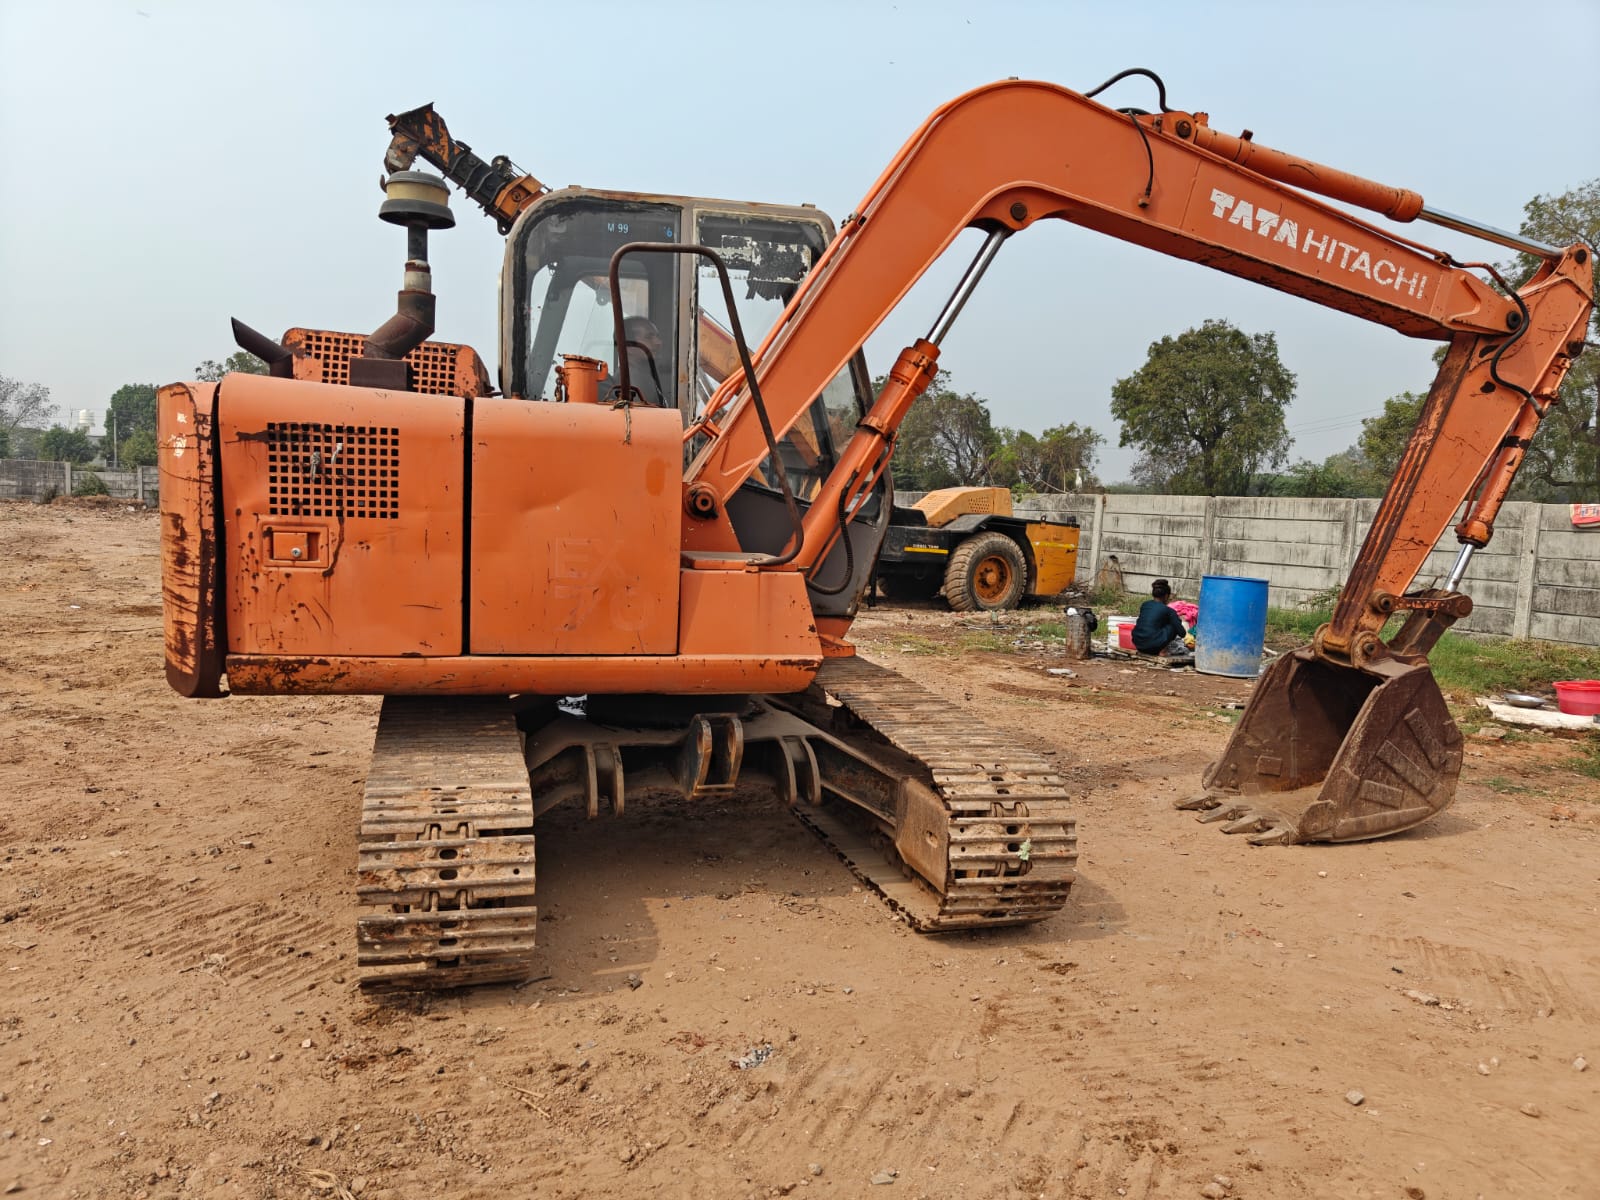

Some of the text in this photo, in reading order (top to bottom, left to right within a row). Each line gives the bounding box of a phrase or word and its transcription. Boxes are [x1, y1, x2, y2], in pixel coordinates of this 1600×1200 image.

[607, 222, 615, 233] M
[1210, 188, 1428, 299] TATA HITACHI
